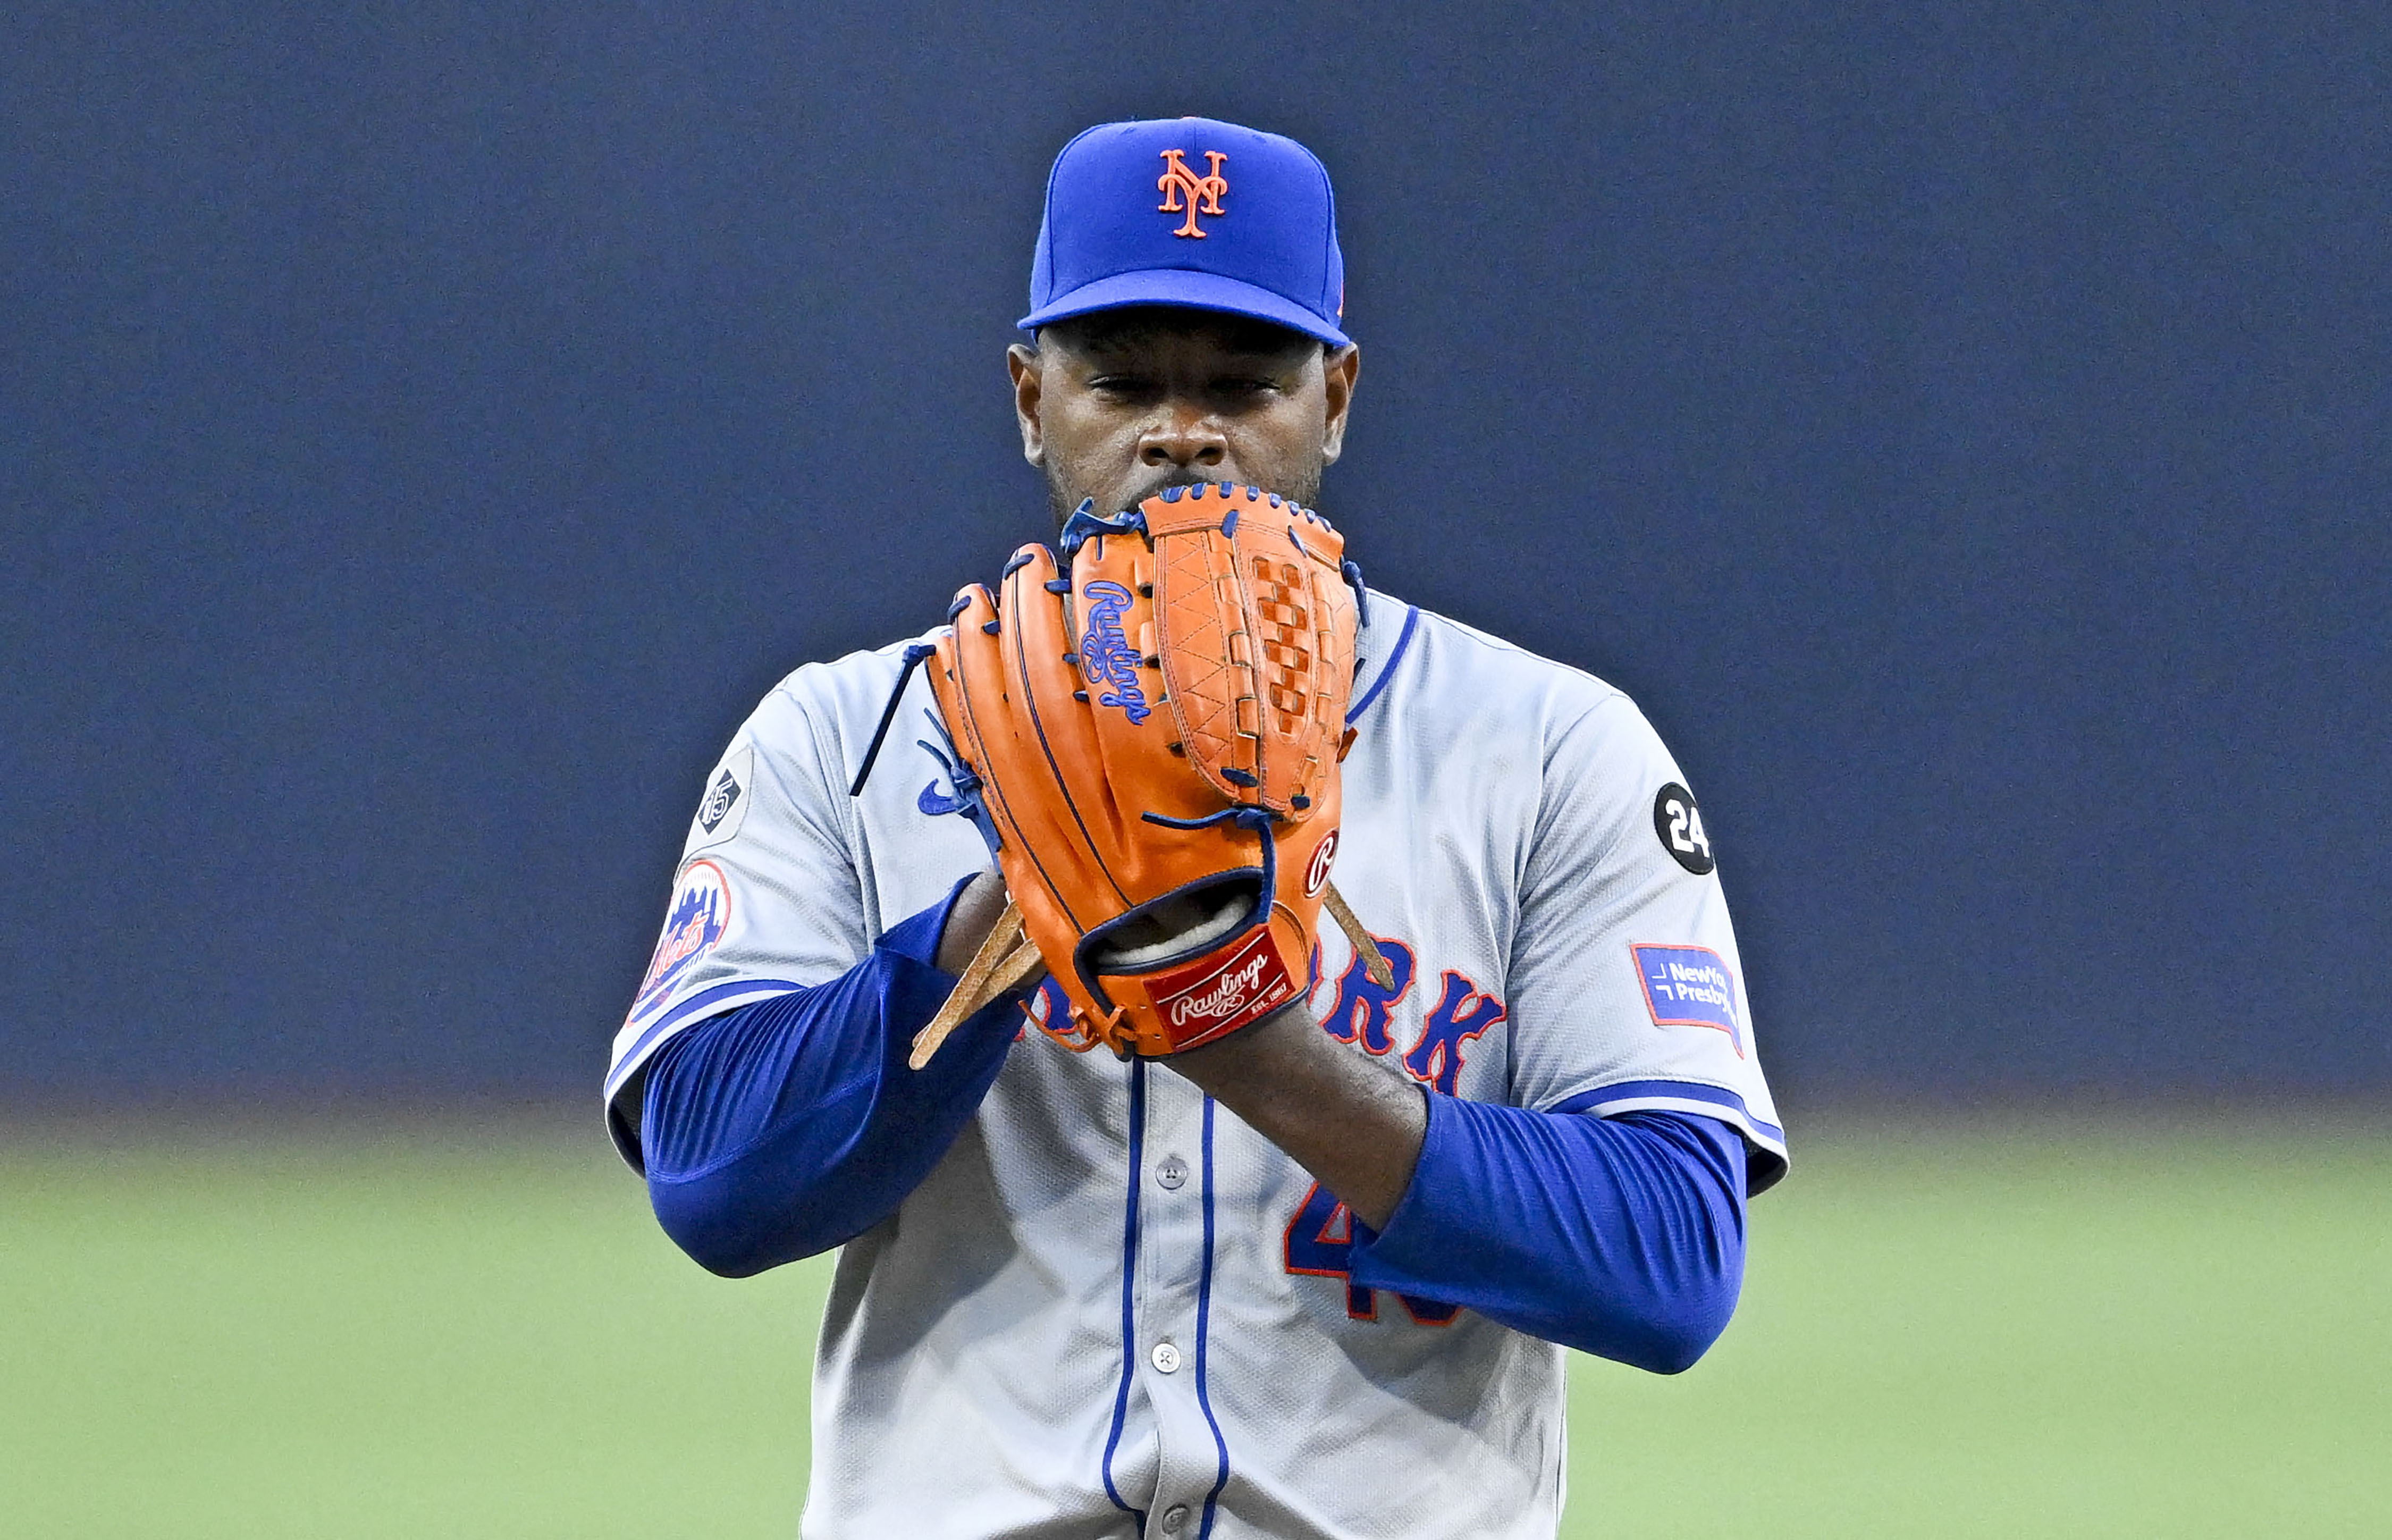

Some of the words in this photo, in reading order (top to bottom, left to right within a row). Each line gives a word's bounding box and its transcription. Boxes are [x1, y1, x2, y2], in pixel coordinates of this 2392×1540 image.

[1157, 149, 1229, 239] NY
[1081, 579, 1151, 726] Rawlings
[702, 777, 734, 825] 15
[1665, 798, 1711, 858] 24
[1170, 954, 1269, 1027] Rawlings
[1306, 931, 1507, 1098] RK
